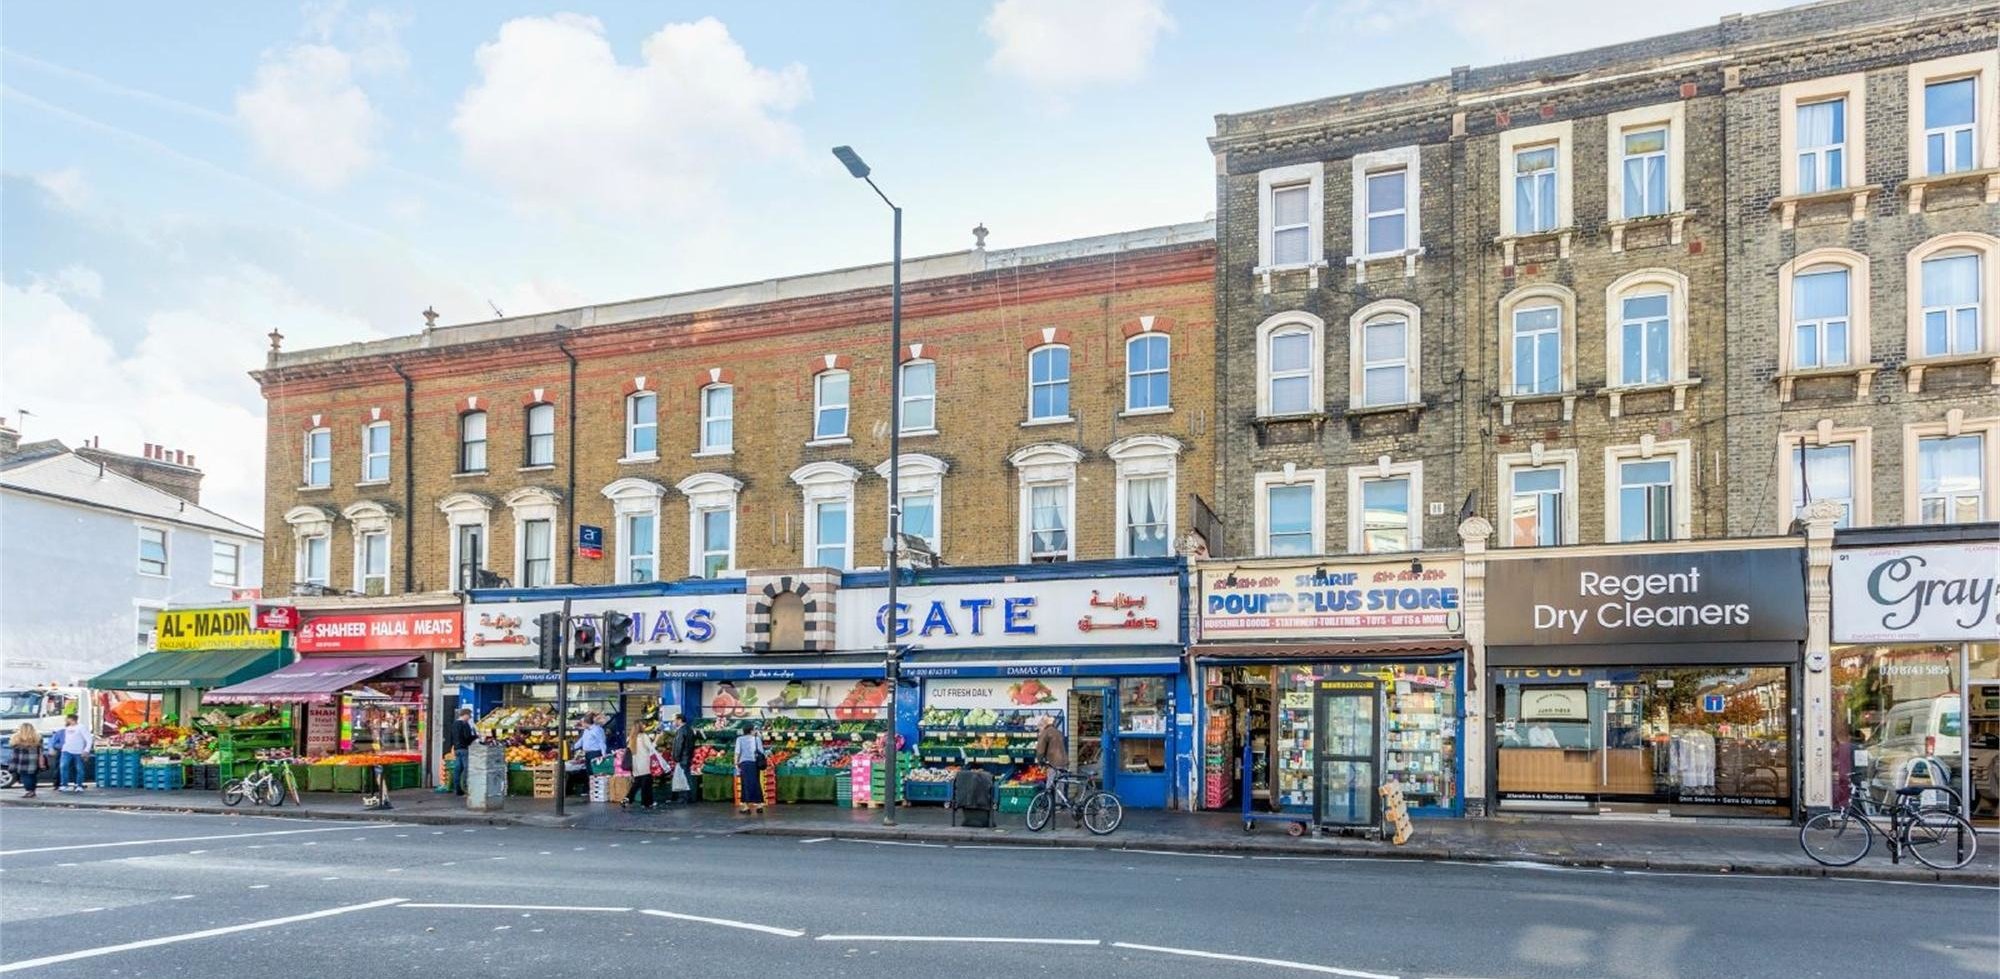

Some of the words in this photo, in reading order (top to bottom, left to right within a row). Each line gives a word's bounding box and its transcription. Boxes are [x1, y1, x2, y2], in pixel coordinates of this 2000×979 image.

[1295, 573, 1358, 588] SHARIF
[1580, 567, 1700, 600] Regent
[1208, 593, 1295, 614] POUND
[1298, 589, 1362, 612] PLUS
[1367, 587, 1459, 610] STORE
[1867, 555, 1994, 630] Gray
[162, 611, 276, 637] AL-MADIN
[876, 596, 1038, 636] GATE
[1246, 618, 1271, 627] GOODS
[1366, 615, 1386, 625] TOYS
[1391, 615, 1413, 624] GIFTS
[1414, 615, 1420, 624] &
[1534, 605, 1588, 634] Dry
[1597, 602, 1750, 628] Cleaners
[316, 622, 366, 637] SHAHEER
[371, 620, 409, 635] HALAL
[414, 618, 453, 634] MEATS
[1007, 667, 1038, 675] DAMAS
[1041, 666, 1062, 674] GATE
[932, 688, 946, 697] CUT
[948, 688, 970, 697] FRESH
[972, 688, 993, 697] DAILY
[1753, 797, 1777, 805] Service
